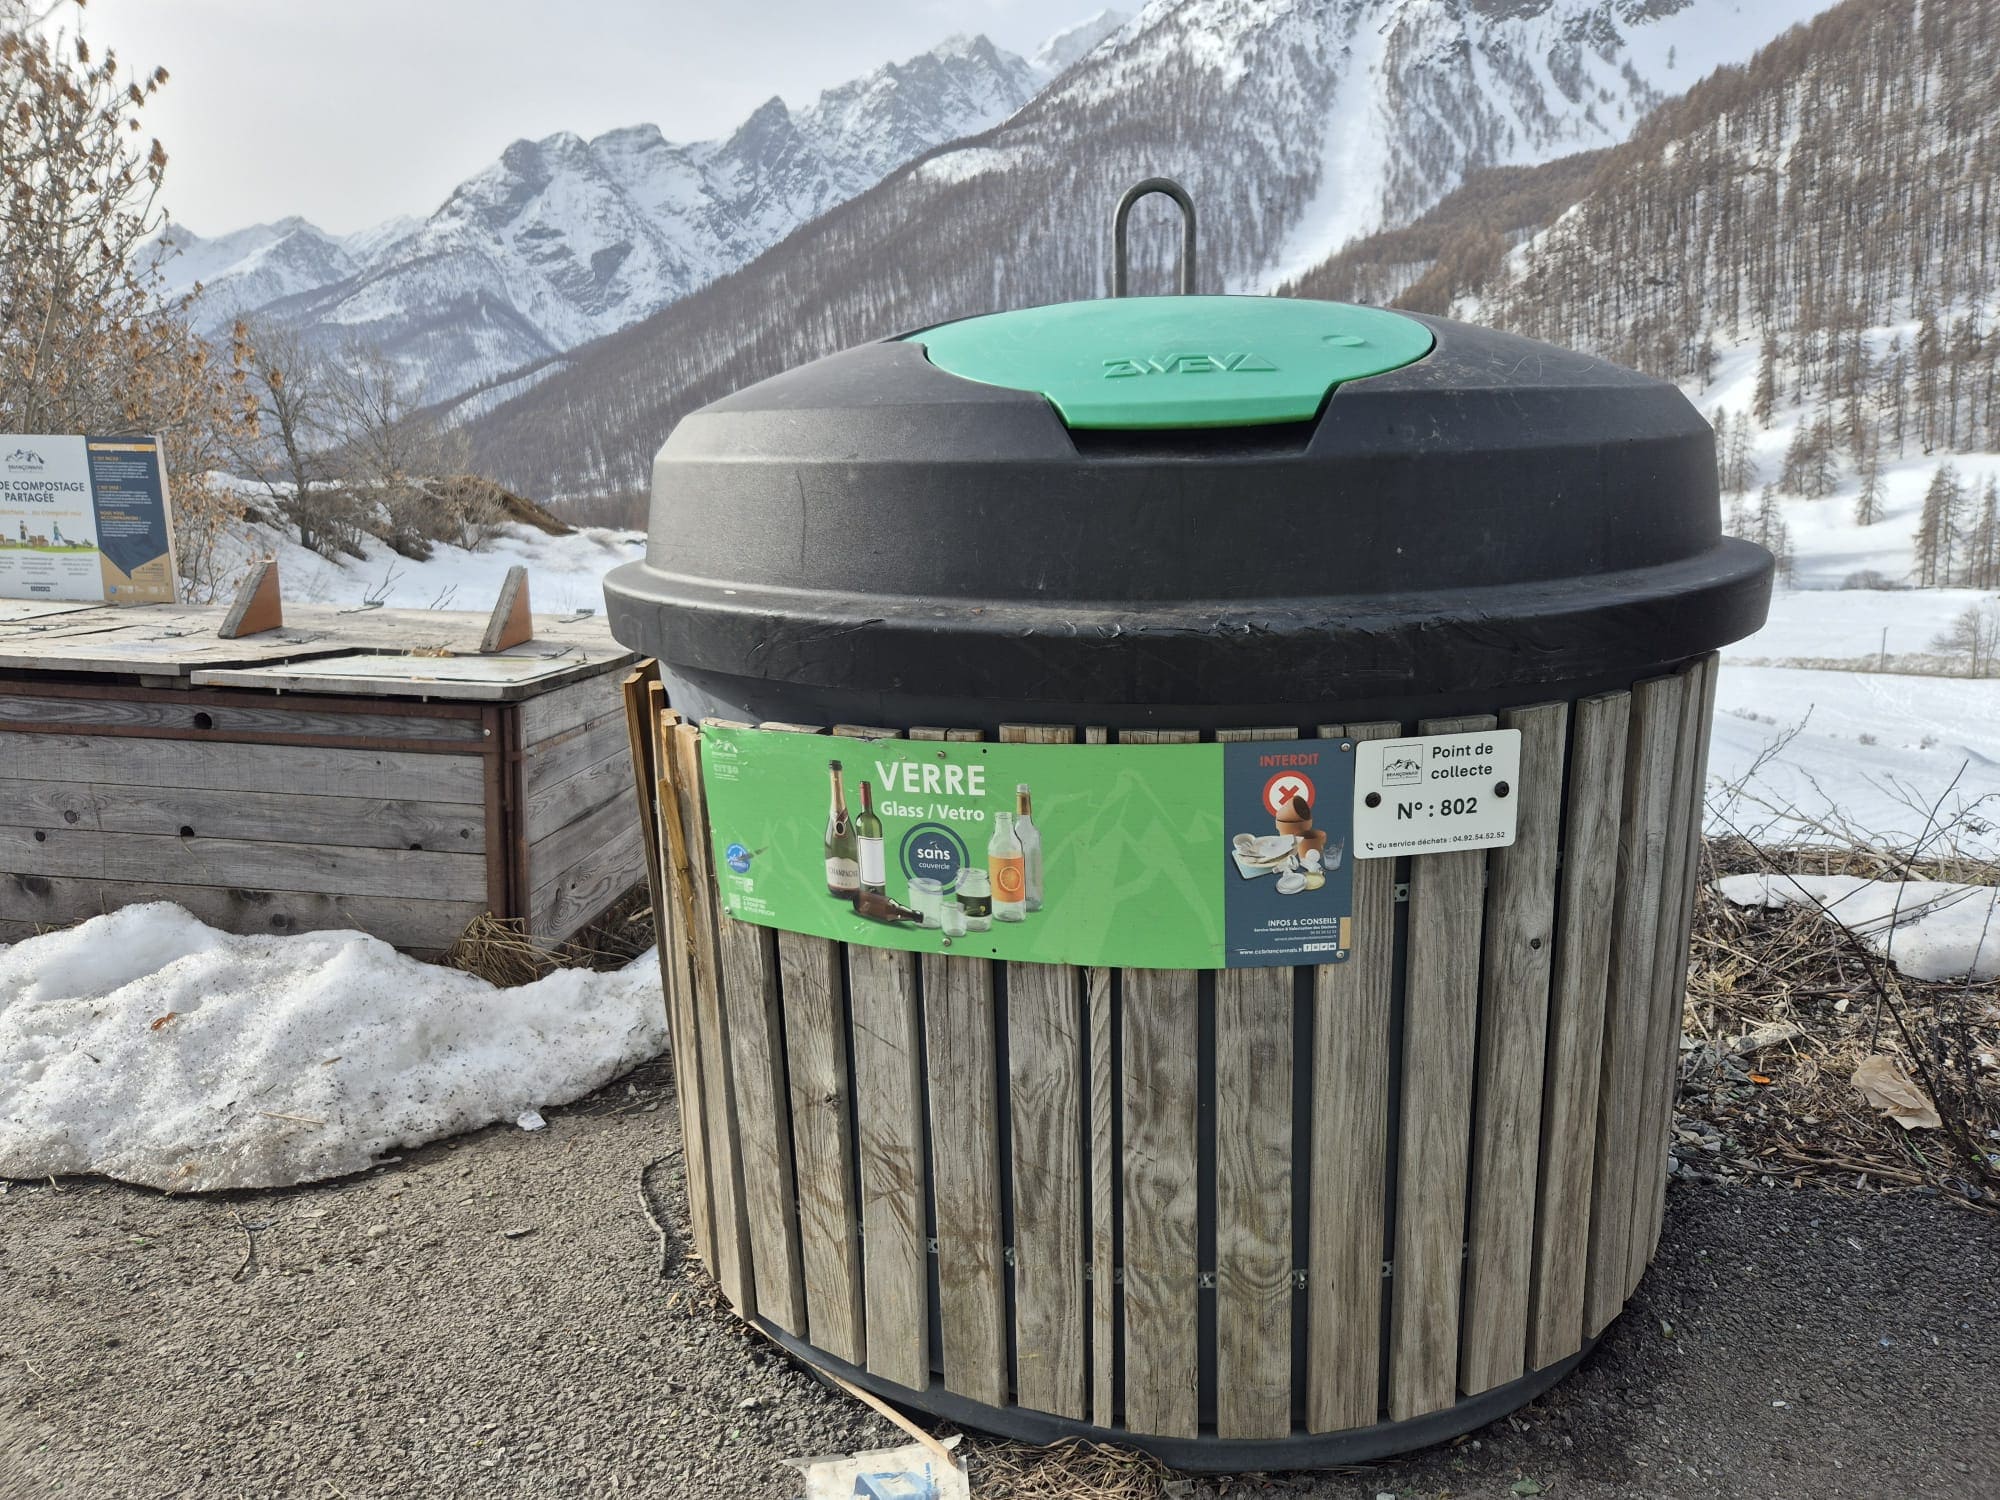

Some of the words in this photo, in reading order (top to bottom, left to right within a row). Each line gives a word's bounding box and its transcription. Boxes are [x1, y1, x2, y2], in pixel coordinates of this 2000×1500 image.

[12, 481, 85, 492] COMPOSTAGE
[4, 490, 55, 503] PARTAGÉE
[1432, 744, 1472, 759] Point
[1475, 743, 1494, 756] de
[1259, 752, 1319, 768] INTERDIT
[875, 760, 986, 796] VERRE
[1431, 764, 1493, 780] collecte
[881, 801, 924, 818] Glass
[927, 803, 934, 820] /
[936, 803, 985, 821] Vetro
[1397, 801, 1423, 820] N°
[1429, 804, 1434, 818] :
[1440, 797, 1478, 816] 802
[1388, 840, 1416, 848] service
[1417, 838, 1447, 846] déchets
[917, 847, 951, 860] sans
[918, 862, 951, 870] couvercle
[1268, 919, 1291, 927] INFOS
[1300, 917, 1337, 925] CONSEILS
